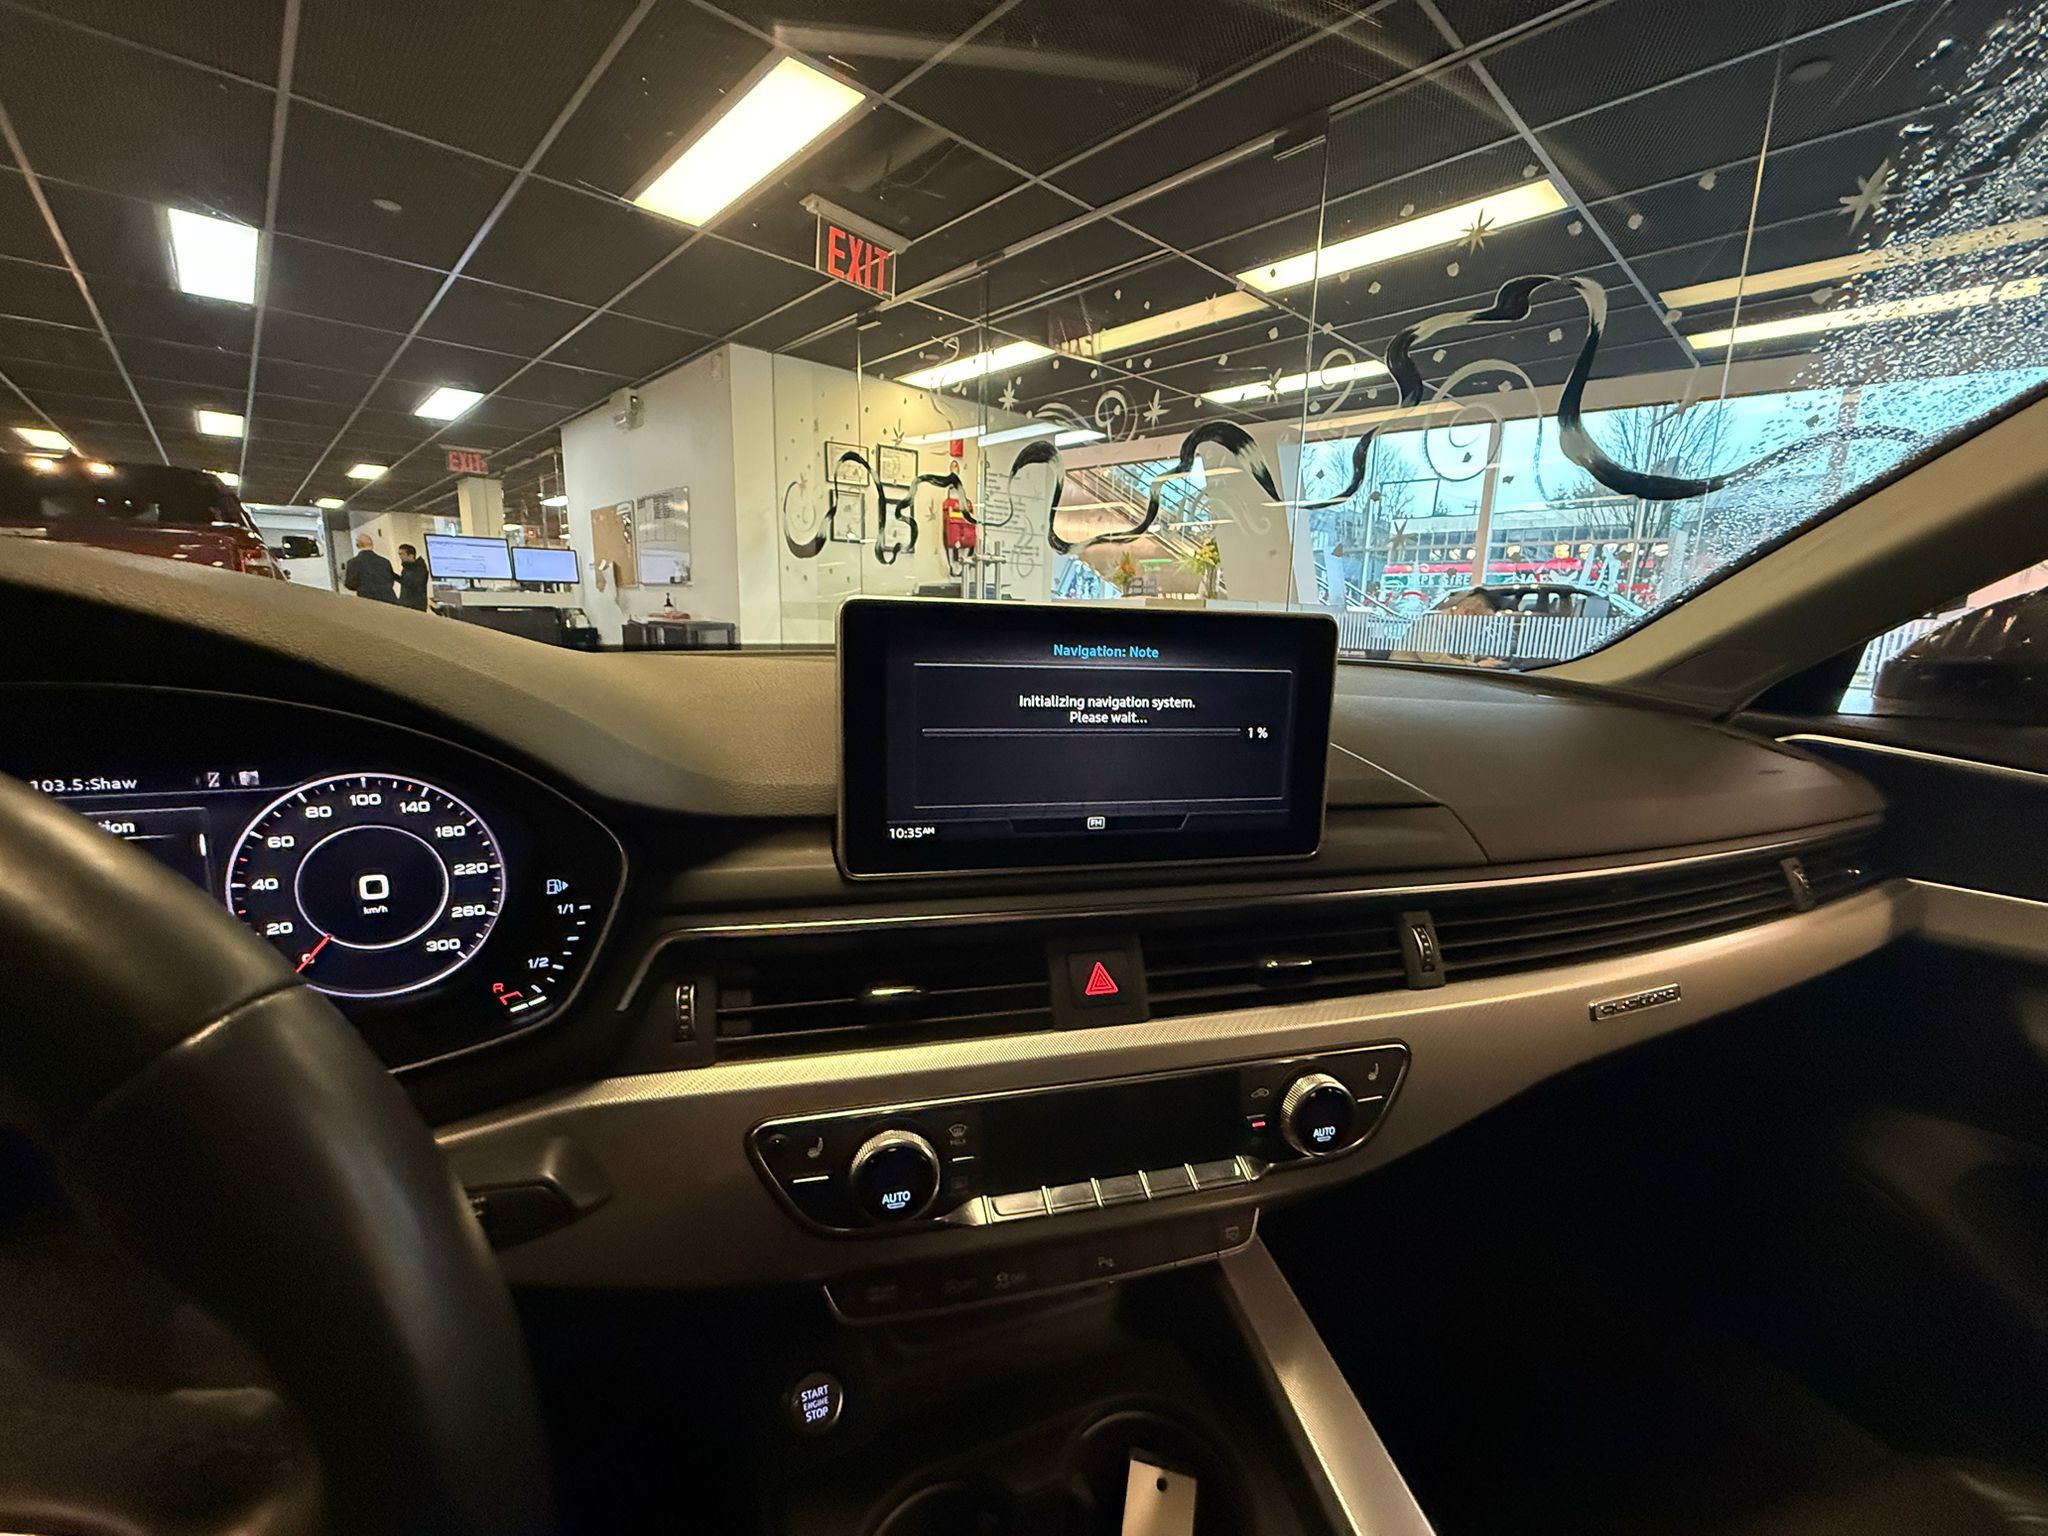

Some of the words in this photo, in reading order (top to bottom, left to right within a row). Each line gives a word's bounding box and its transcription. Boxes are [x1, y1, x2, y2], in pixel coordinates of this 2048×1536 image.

[828, 225, 889, 295] EXIT
[449, 450, 480, 473] EXIT
[1053, 644, 1126, 660] Navigation:
[1129, 646, 1160, 659] Note
[1019, 694, 1085, 712] Initializing
[1087, 696, 1150, 711] navigation
[1151, 697, 1196, 712] system.
[1069, 710, 1109, 724] Please
[1110, 712, 1148, 724] wait...
[349, 793, 382, 807] 100
[399, 800, 431, 814] 140
[304, 805, 332, 819] 80
[435, 824, 466, 838] 180
[267, 835, 295, 849] 60
[453, 862, 488, 875] 220
[251, 878, 279, 891] 40
[358, 874, 390, 900] 0
[363, 905, 389, 915] km/h
[451, 904, 486, 918] 260
[557, 903, 574, 914] 1/1
[266, 922, 294, 936] 20
[425, 938, 461, 952] 300
[527, 956, 549, 969] 1/2
[1313, 1125, 1336, 1139] AUTO
[881, 1190, 911, 1206] AUTO
[801, 1383, 829, 1403] START
[803, 1395, 829, 1412] ENGINE
[805, 1405, 829, 1423] STOP
